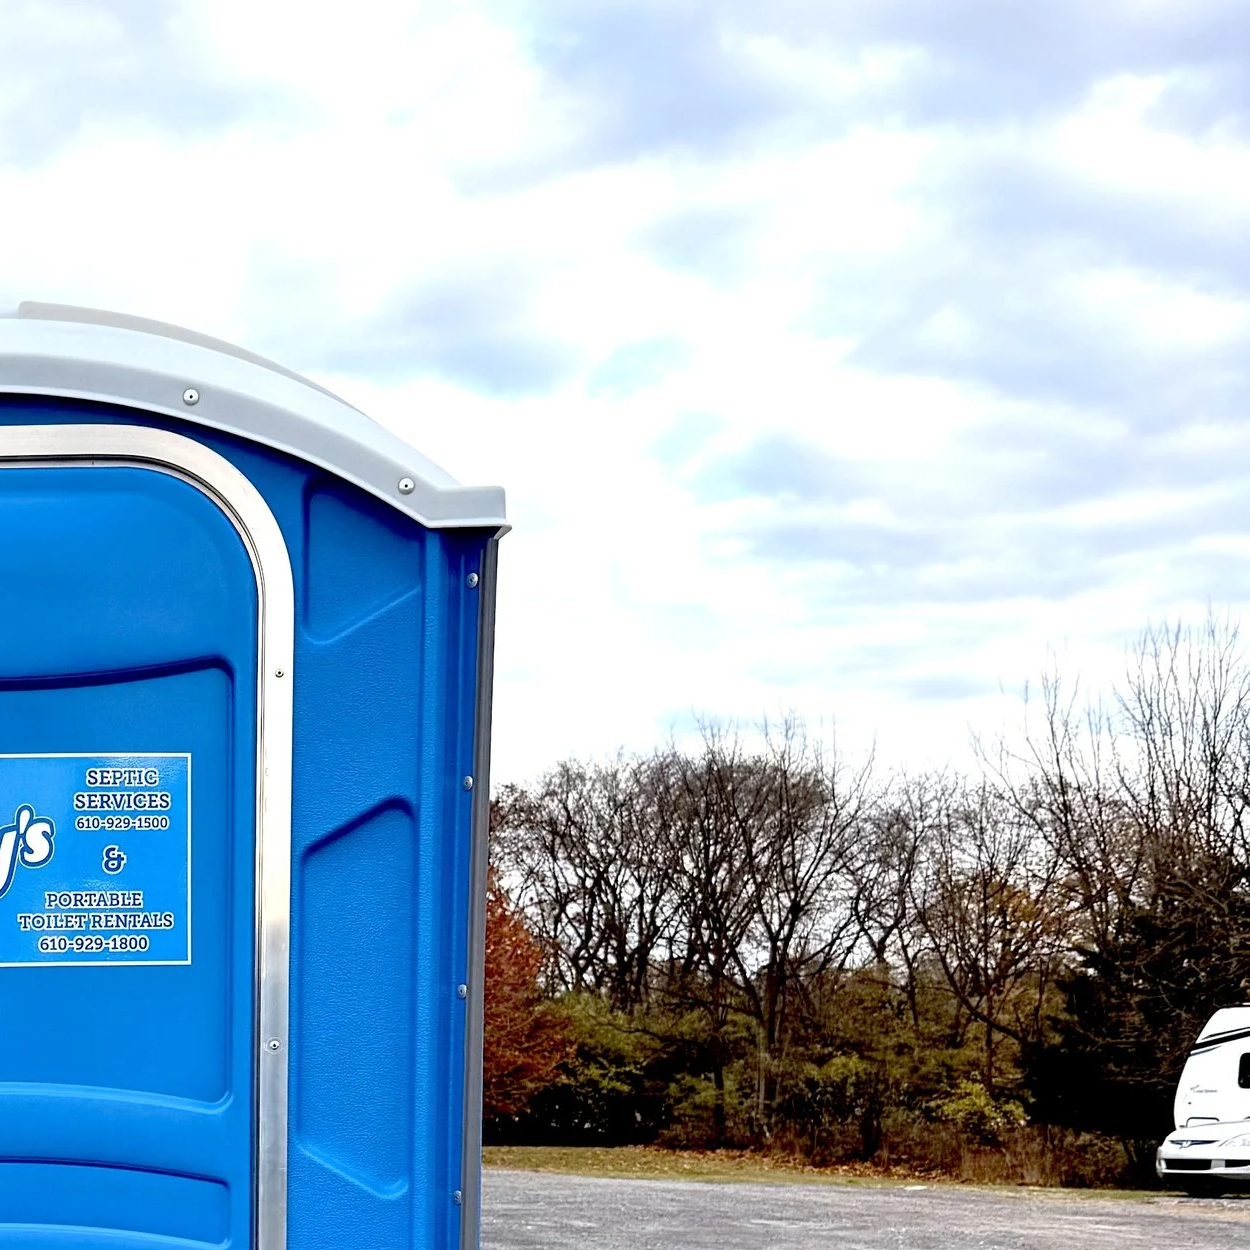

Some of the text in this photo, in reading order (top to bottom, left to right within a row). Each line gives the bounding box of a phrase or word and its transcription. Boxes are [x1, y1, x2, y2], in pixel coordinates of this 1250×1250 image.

[87, 769, 158, 786] SEPTIC
[75, 793, 170, 809] SERVICES
[76, 816, 169, 829] 610-929-1500
[103, 846, 126, 872] &
[46, 892, 142, 908] PORTABLE
[18, 913, 173, 930] TOILET RENTALS
[39, 936, 148, 952] 610-929-1800
